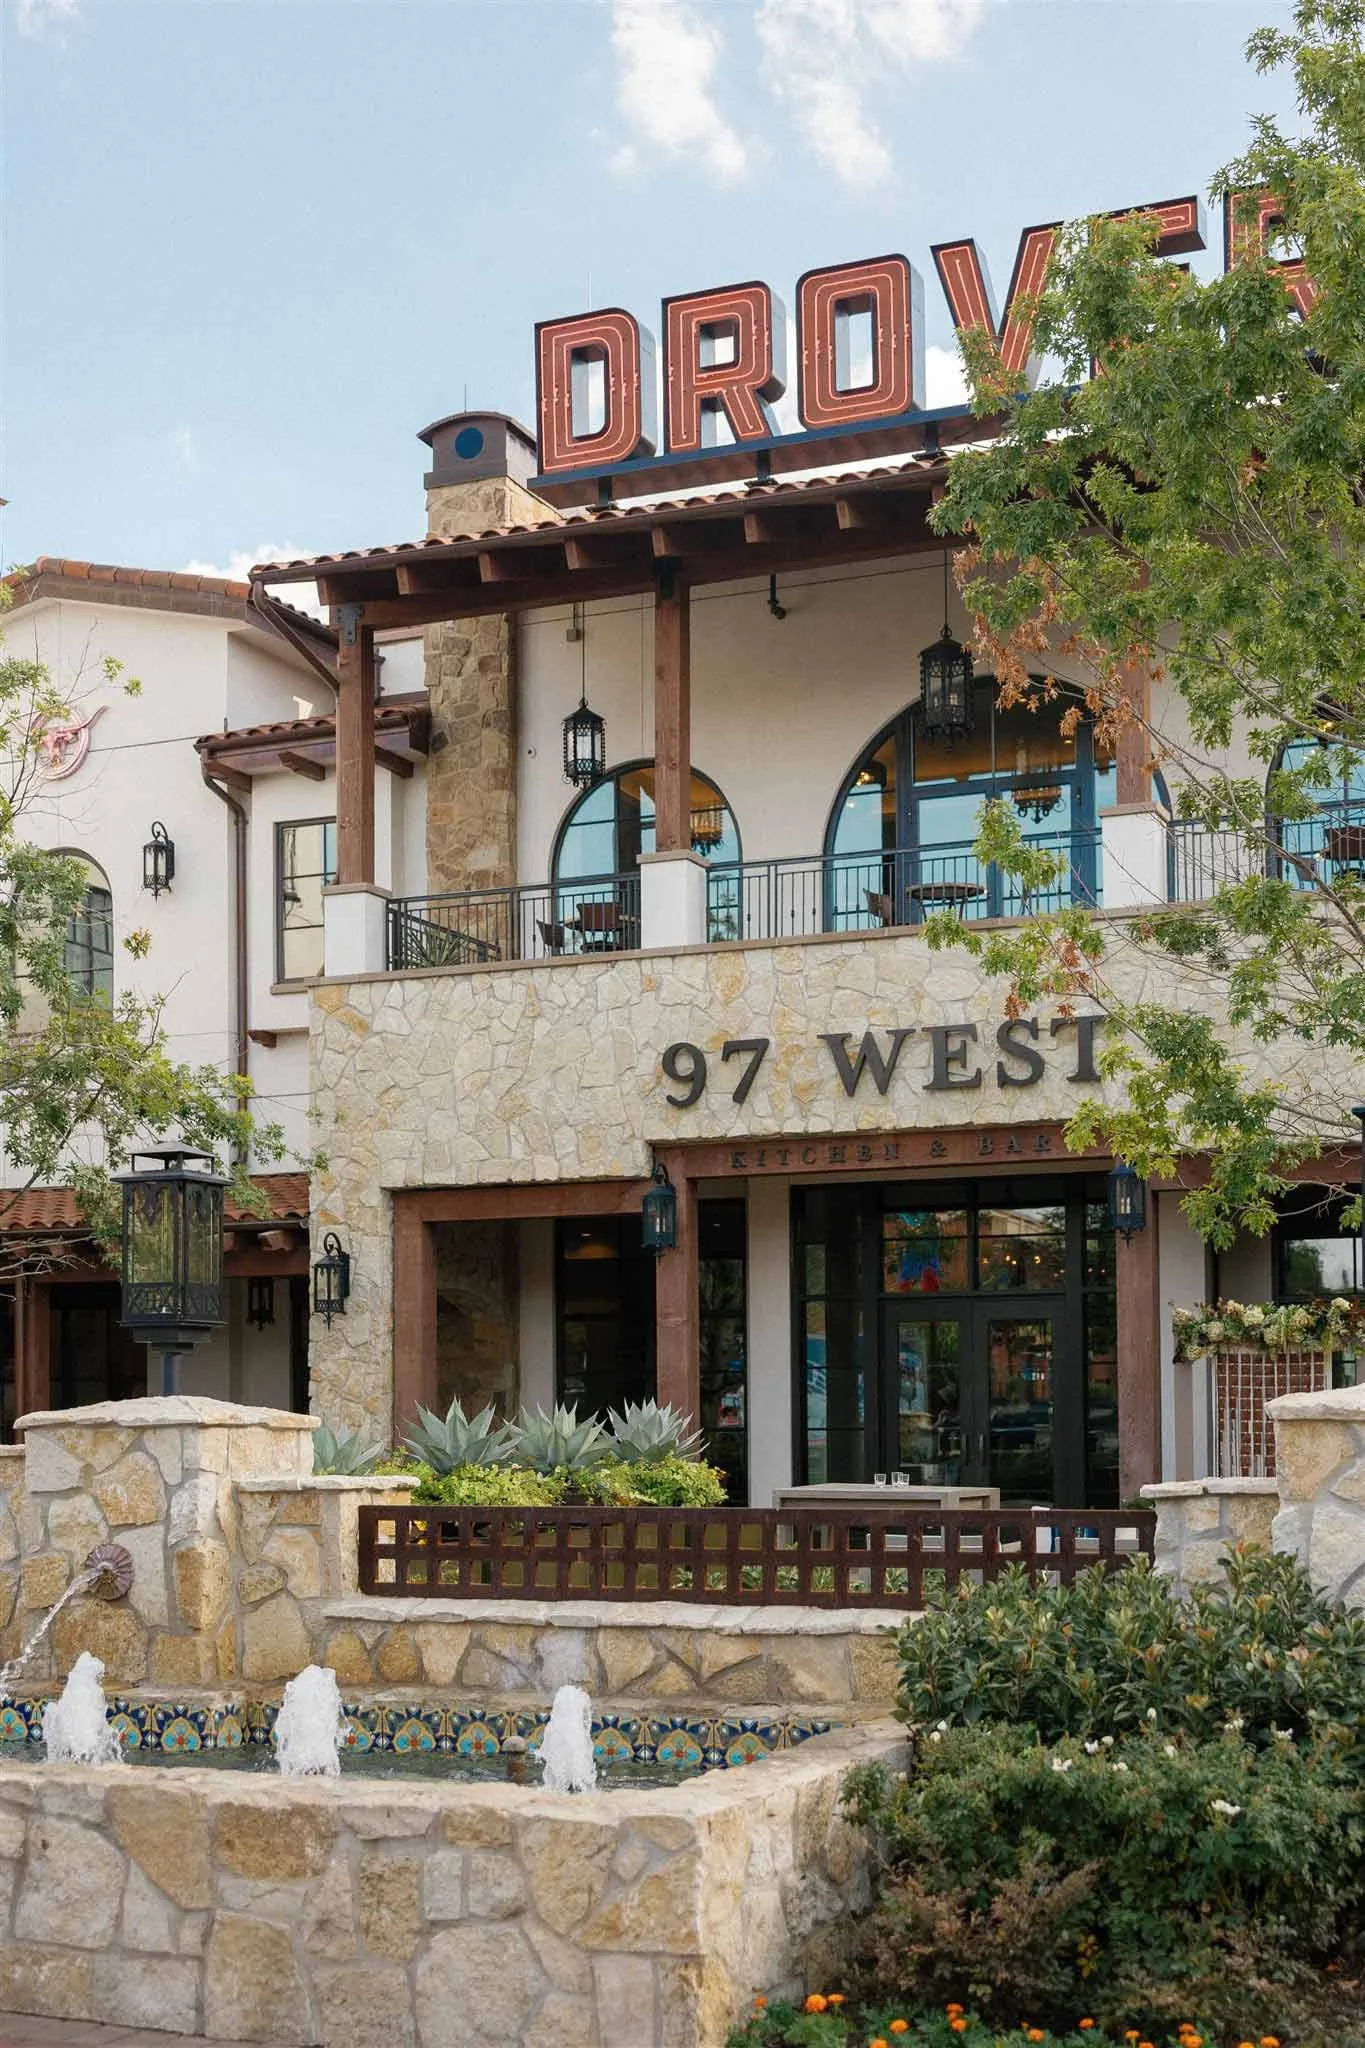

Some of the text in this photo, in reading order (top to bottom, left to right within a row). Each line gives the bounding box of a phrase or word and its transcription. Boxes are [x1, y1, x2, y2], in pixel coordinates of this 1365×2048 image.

[534, 180, 1330, 475] DROV
[661, 1014, 1107, 1108] 97 WEST
[730, 1134, 1052, 1169] KITCHEN & BAR
